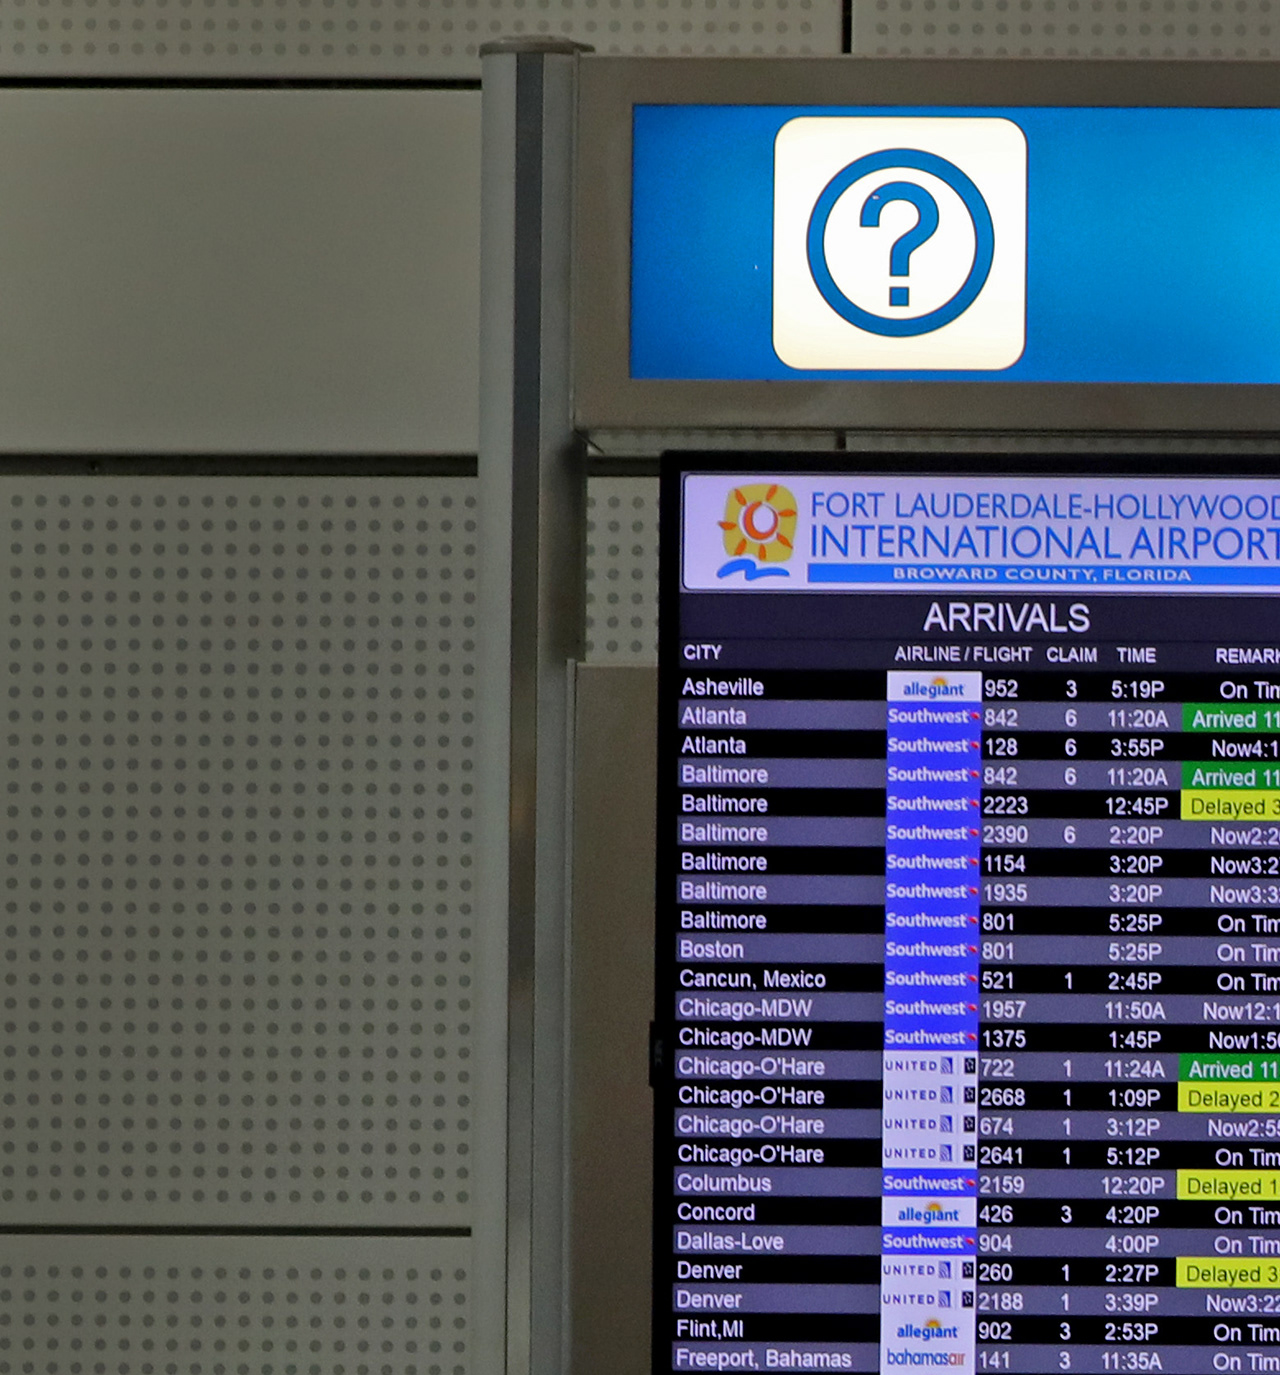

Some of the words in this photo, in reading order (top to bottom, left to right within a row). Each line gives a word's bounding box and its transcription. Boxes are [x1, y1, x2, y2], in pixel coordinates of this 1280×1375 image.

[812, 492, 885, 517] FORT
[812, 525, 1121, 558] INTERNATIONAL
[891, 567, 1000, 582] BROWARD
[1006, 569, 1096, 581] COUNTY,
[1101, 567, 1194, 582] FLORIDA
[924, 603, 1089, 632] ARRIVALS
[682, 645, 721, 659] CITY
[894, 645, 962, 664] AIRLINE
[974, 645, 1032, 662] FLIGHT
[1046, 646, 1097, 662] CLAIM
[1116, 646, 1157, 665] TIME
[681, 795, 769, 813] Baltimore
[885, 795, 971, 813] Southwest
[980, 796, 1032, 815] 2223
[1106, 797, 1168, 815] 12:45P
[1192, 798, 1265, 819] Delayed
[675, 1349, 758, 1371] Freeport,
[761, 1348, 853, 1369] Bahamas
[888, 1349, 964, 1365] bahamasair
[980, 1352, 1009, 1368] 141
[1059, 1352, 1070, 1371] 3
[1102, 1352, 1162, 1369] 11:35A
[1213, 1353, 1239, 1370] On
